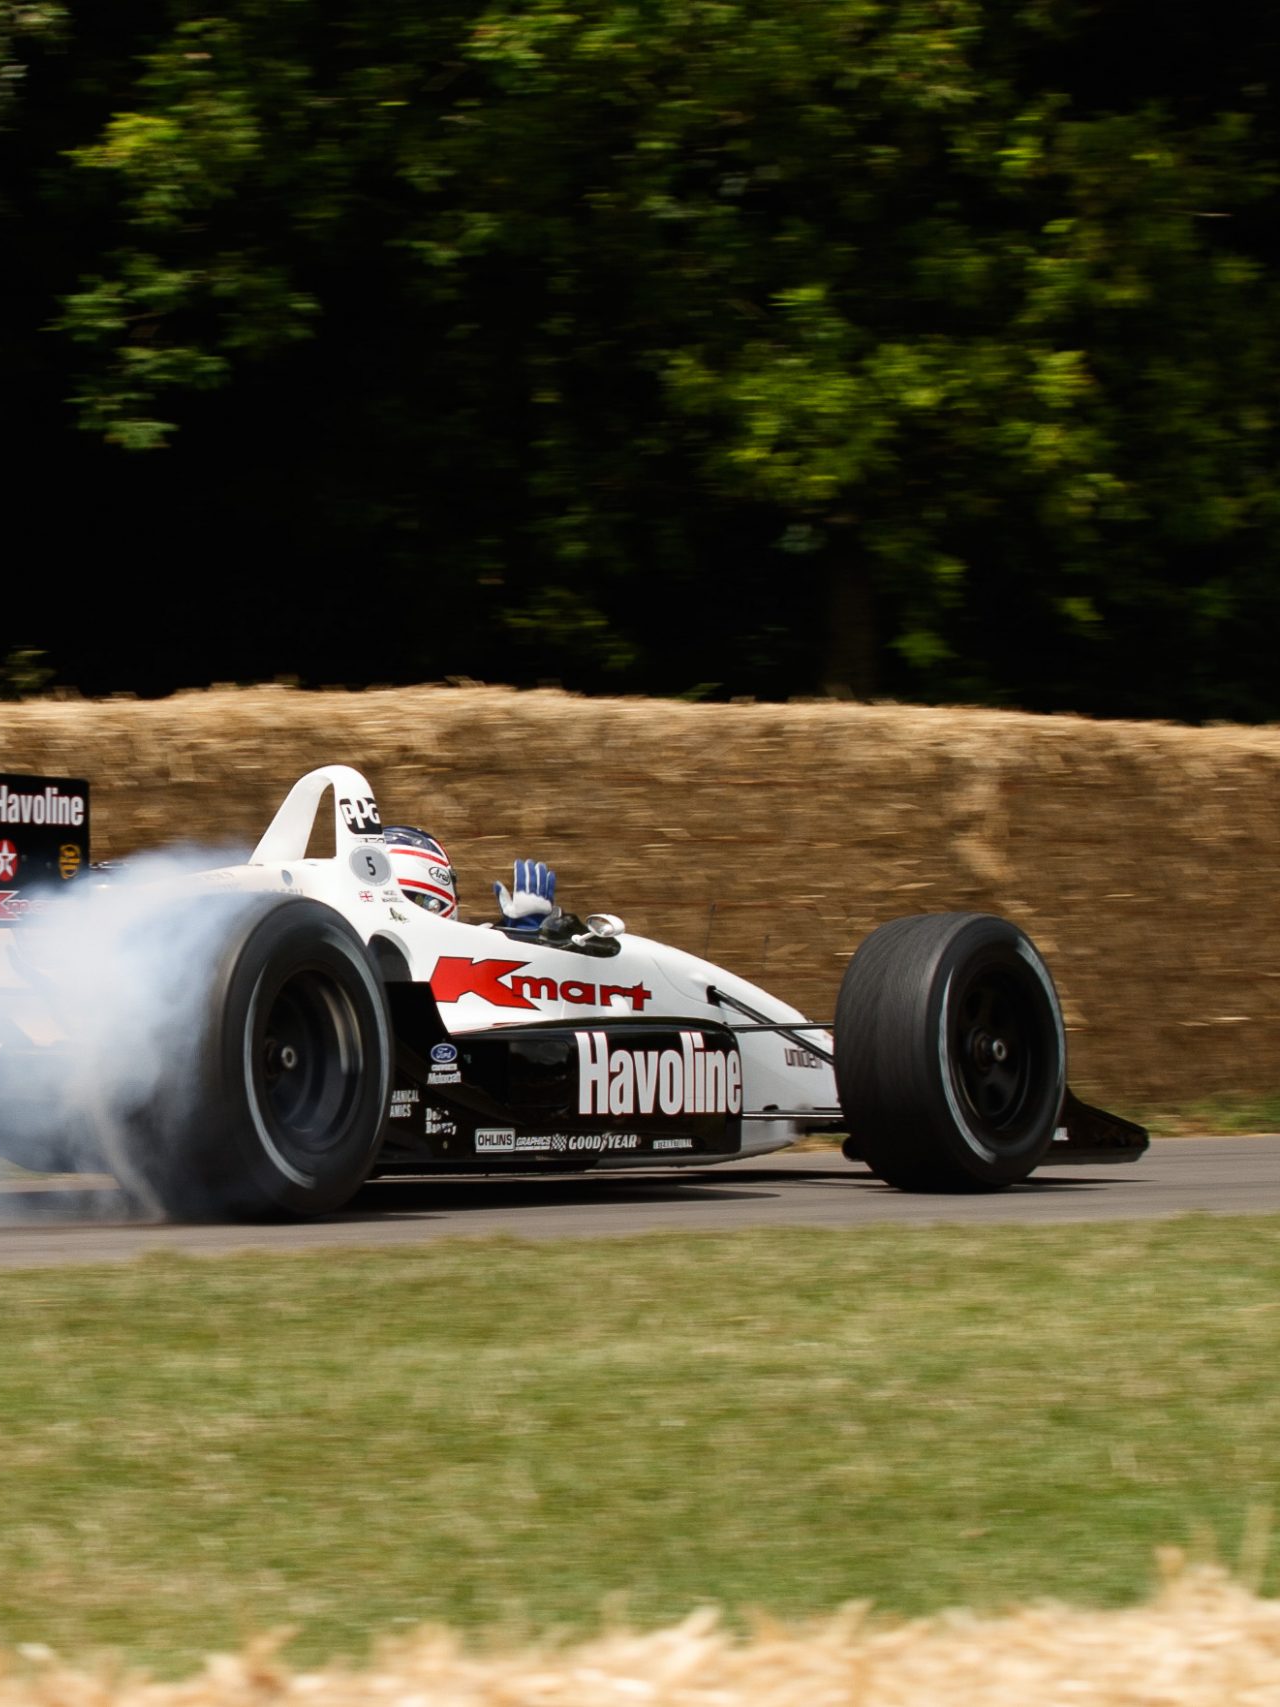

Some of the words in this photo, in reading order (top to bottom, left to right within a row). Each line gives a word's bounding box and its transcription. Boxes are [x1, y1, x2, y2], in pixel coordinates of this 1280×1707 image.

[340, 797, 382, 829] PPG
[365, 856, 377, 876] 5
[430, 956, 652, 1011] Kmart
[575, 1031, 742, 1116] Havoline
